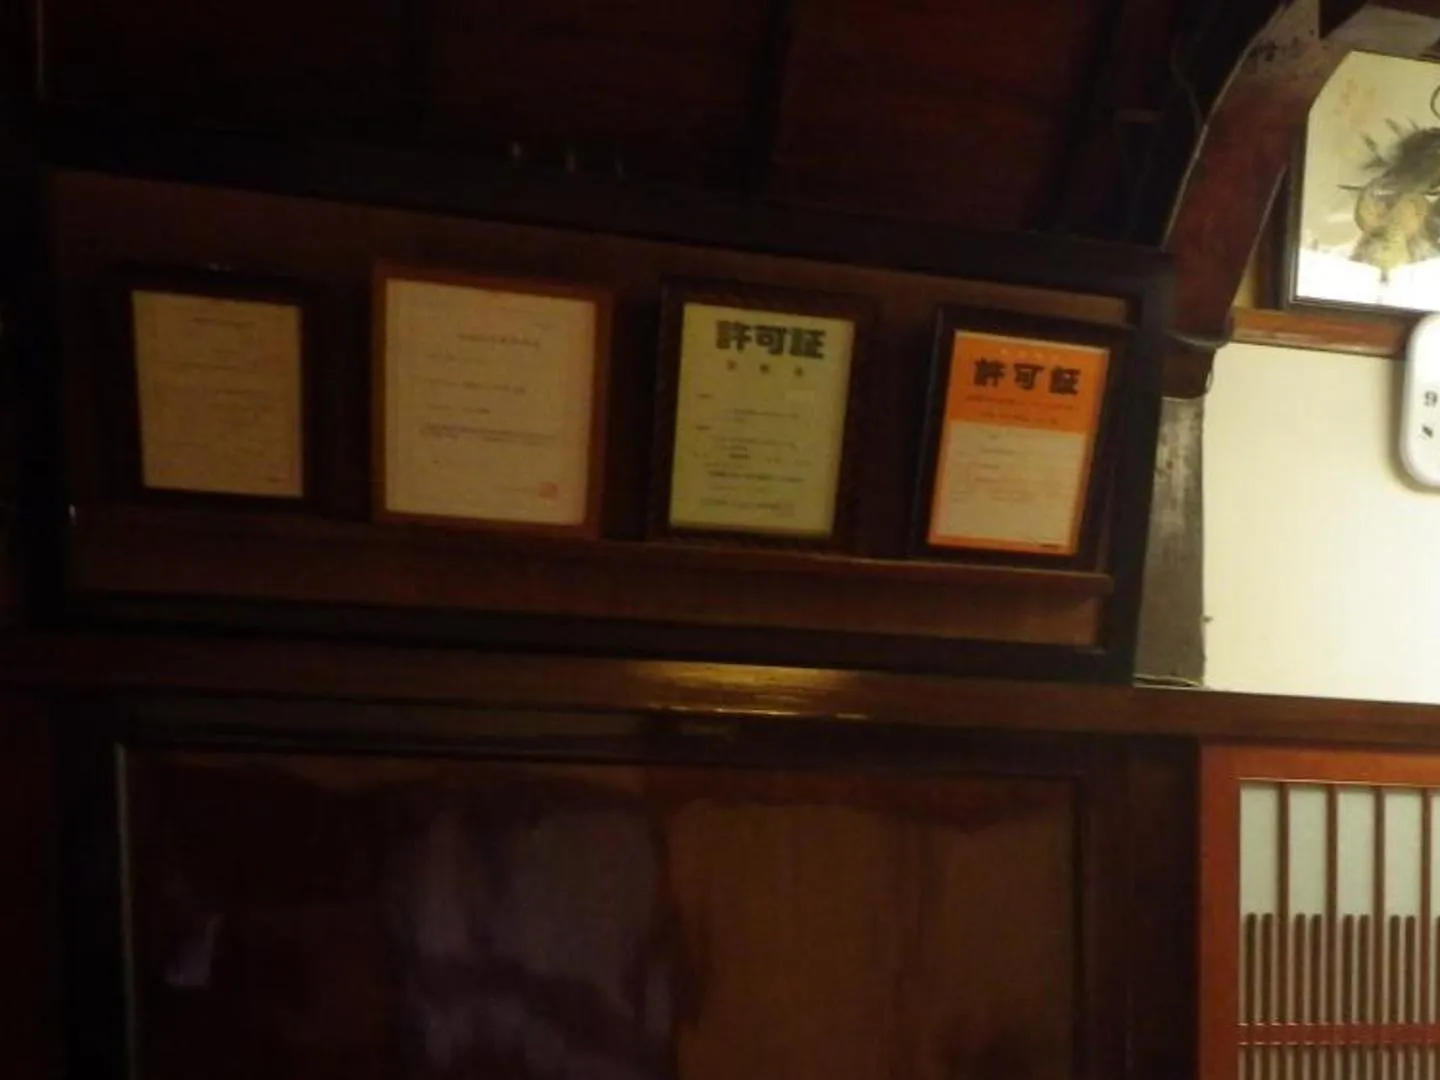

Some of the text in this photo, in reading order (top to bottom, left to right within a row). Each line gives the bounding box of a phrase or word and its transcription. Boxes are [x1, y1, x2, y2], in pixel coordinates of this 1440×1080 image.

[716, 320, 827, 359] 許可証
[973, 356, 1082, 396] 許可証
